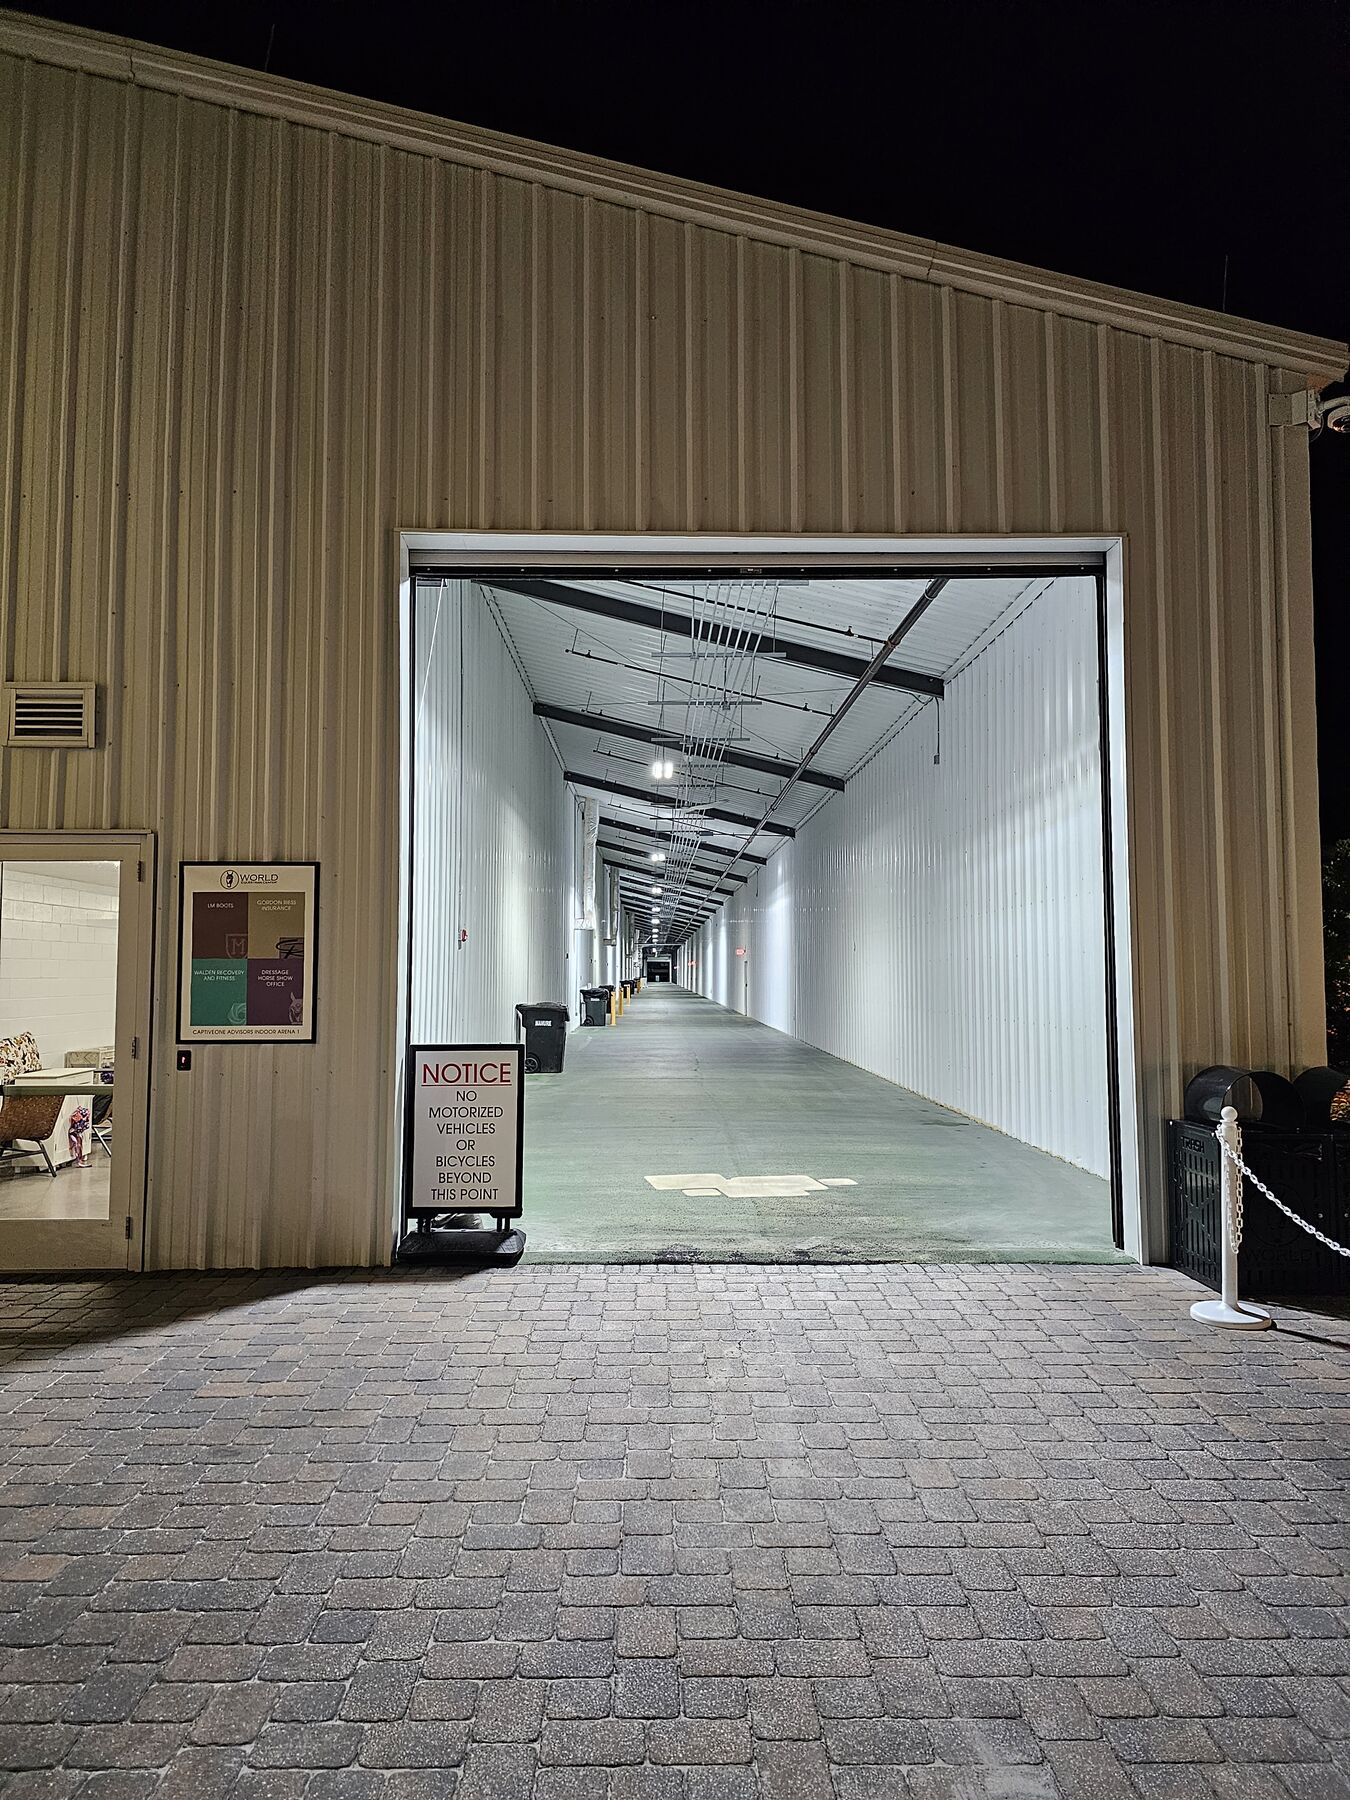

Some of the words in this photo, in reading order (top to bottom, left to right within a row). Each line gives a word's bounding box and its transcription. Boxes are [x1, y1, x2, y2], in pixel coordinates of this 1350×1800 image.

[240, 873, 278, 882] WORLD
[422, 1063, 511, 1084] NOTICE
[456, 1090, 477, 1102] NO
[428, 1106, 503, 1118] MOTORIZED
[436, 1123, 496, 1134] VEHICLES
[456, 1139, 475, 1151] OR
[1181, 1136, 1205, 1153] TRASH
[436, 1155, 495, 1167] BICYCLES
[438, 1172, 492, 1184] BEYOND
[431, 1188, 456, 1200] THIS
[460, 1188, 499, 1200] POINT
[1245, 1248, 1312, 1263] WORLD
